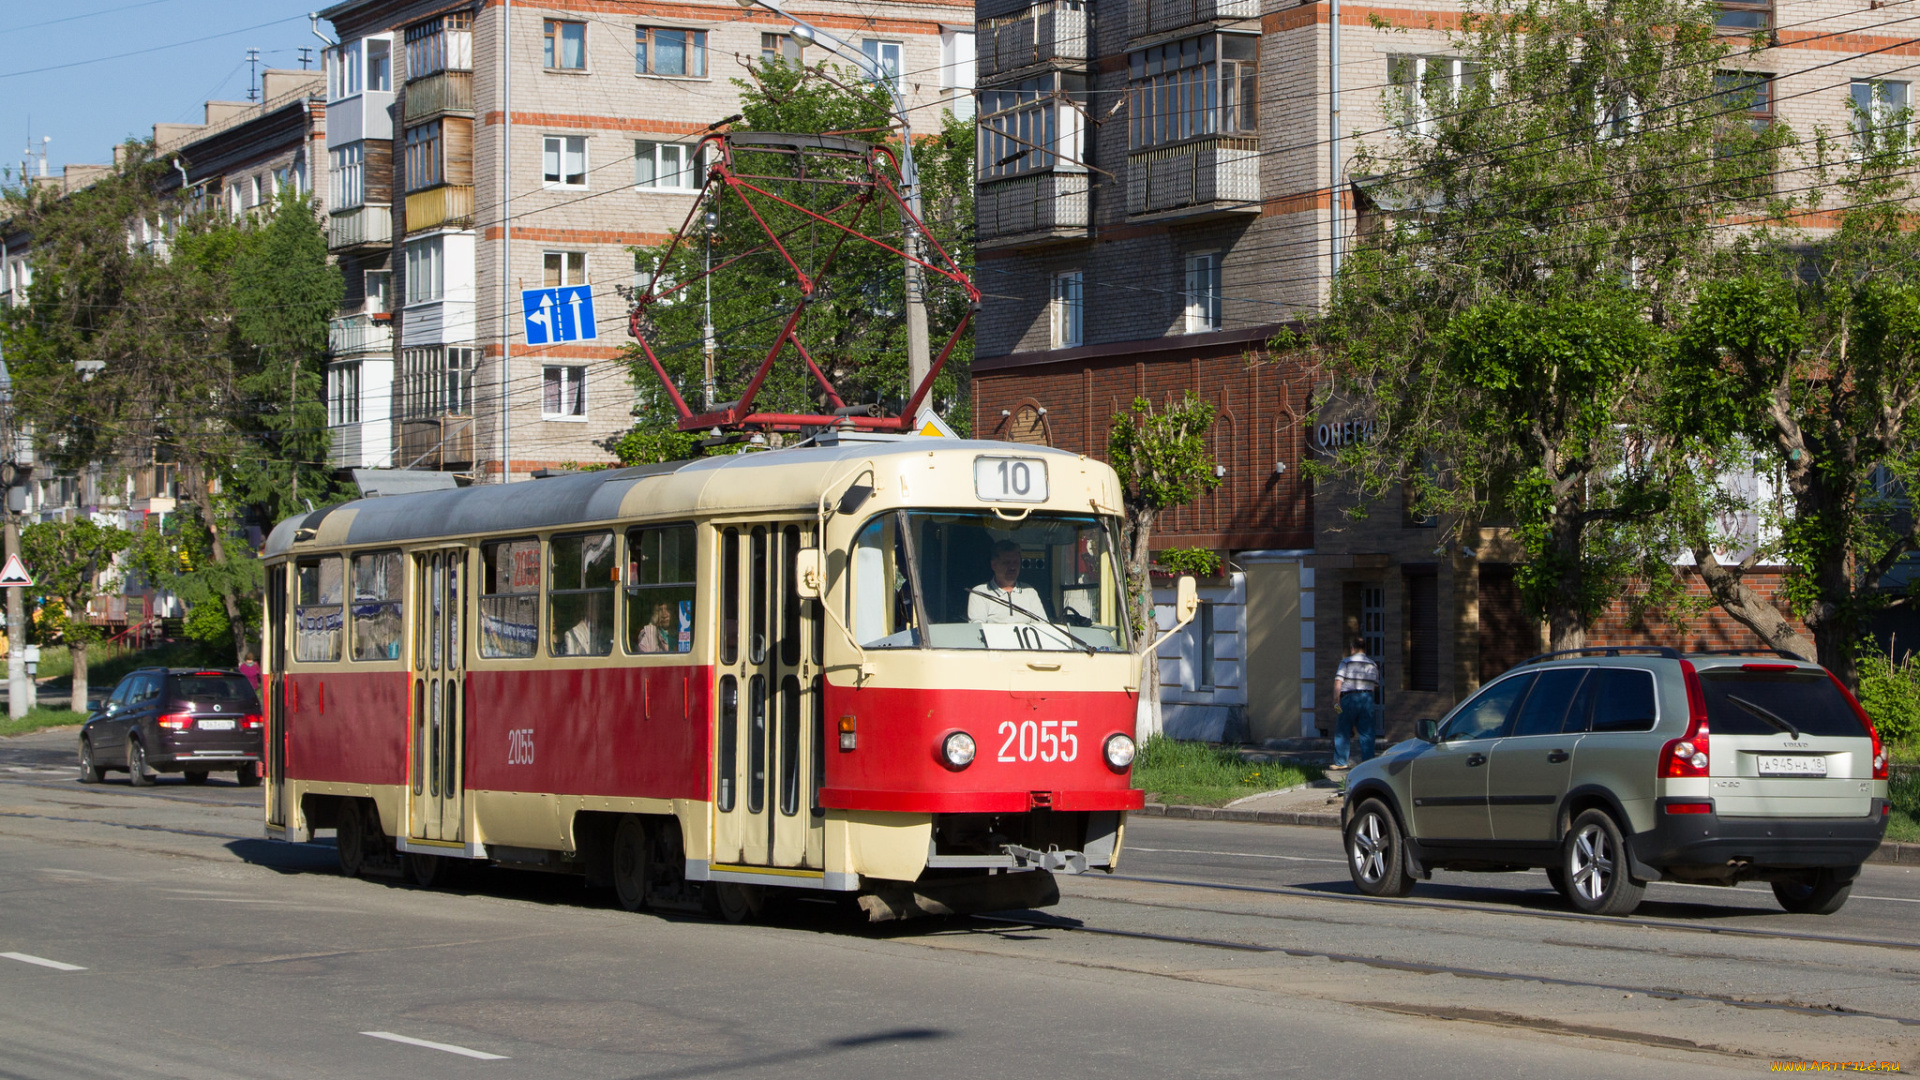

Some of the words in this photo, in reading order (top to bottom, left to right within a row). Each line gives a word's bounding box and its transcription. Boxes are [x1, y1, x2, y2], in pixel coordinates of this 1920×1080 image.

[998, 460, 1031, 495] 10
[514, 550, 540, 587] 2055
[1013, 626, 1043, 650] 10
[508, 729, 534, 765] 2055
[997, 720, 1078, 762] 2055
